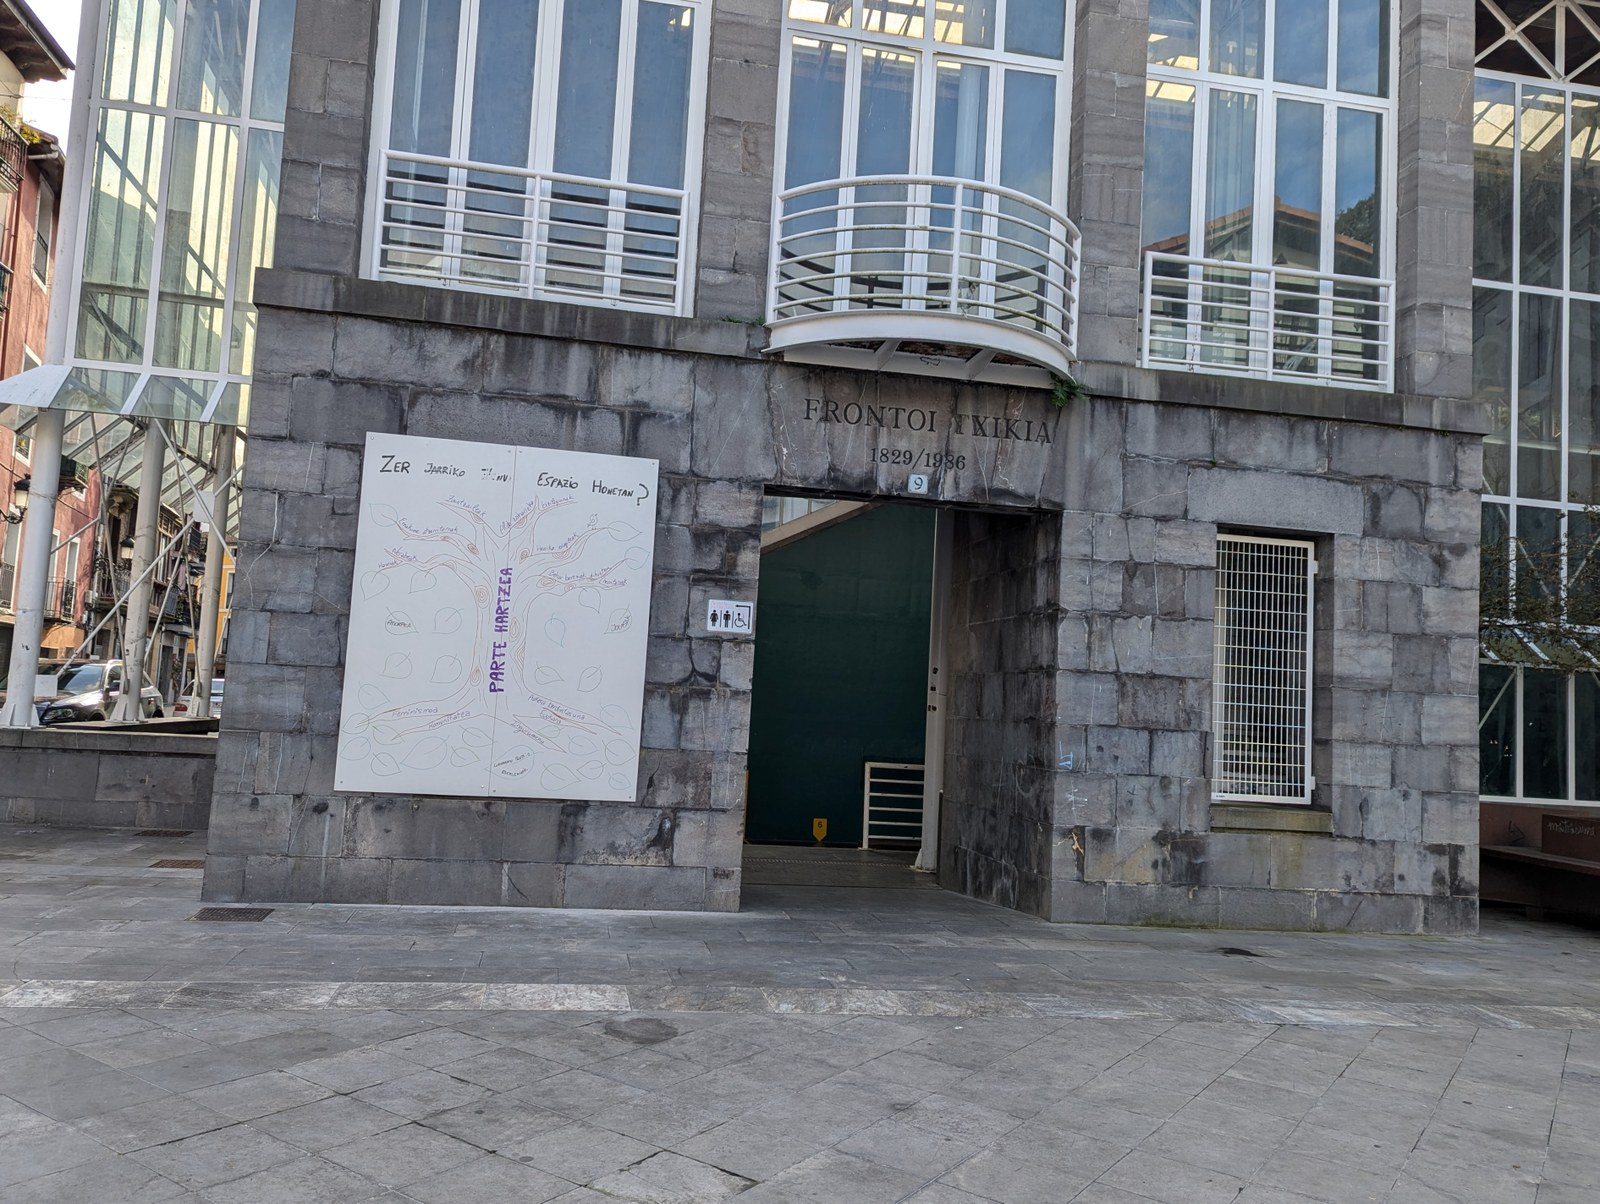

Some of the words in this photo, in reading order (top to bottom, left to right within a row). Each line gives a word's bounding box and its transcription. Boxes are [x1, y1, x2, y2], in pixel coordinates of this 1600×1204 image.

[803, 398, 937, 432] FRONTOI
[953, 413, 1052, 443] TXIKIA
[380, 454, 411, 474] ZER
[870, 447, 966, 471] 1829/1986
[914, 476, 923, 490] 9
[494, 567, 513, 632] HARTZEA
[489, 641, 507, 693] PARTE
